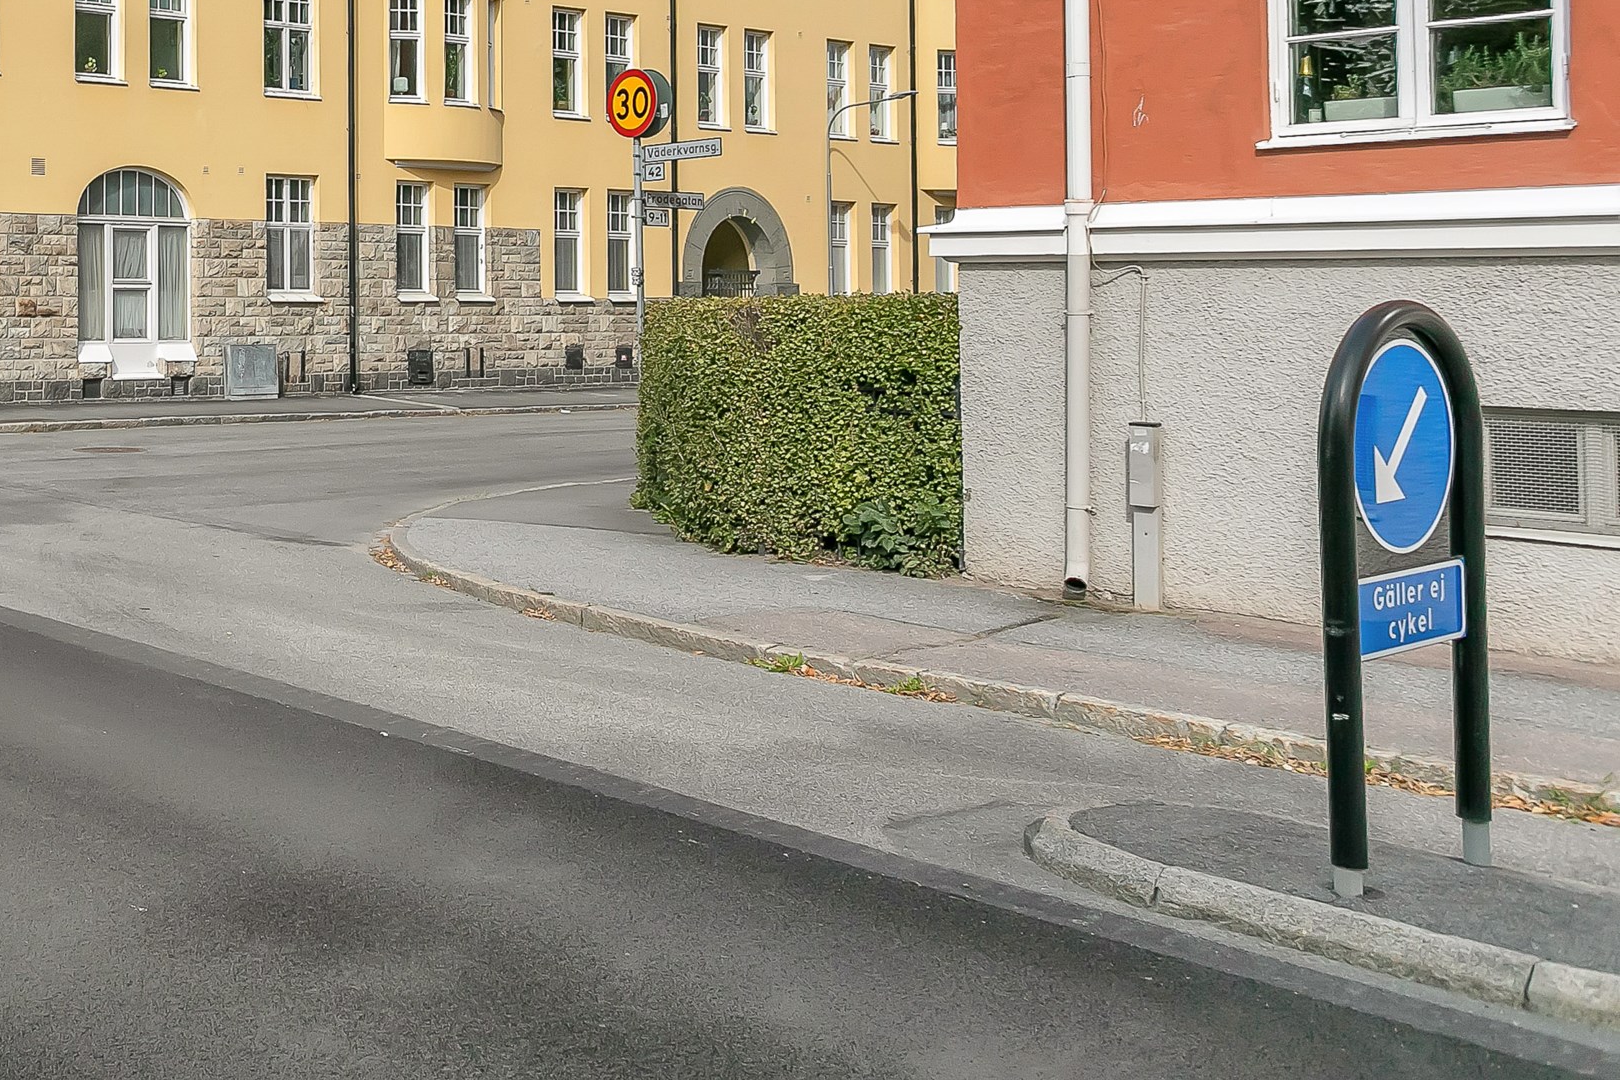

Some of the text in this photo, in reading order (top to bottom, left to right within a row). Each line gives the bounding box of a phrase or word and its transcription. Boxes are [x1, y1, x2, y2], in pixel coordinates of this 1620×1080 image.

[616, 86, 649, 120] 30
[646, 143, 719, 159] Väderkvarnsg.
[648, 166, 662, 177] 42
[648, 212, 667, 224] 9-11
[1373, 573, 1445, 611] Gäller ej
[1388, 607, 1433, 643] cykel
